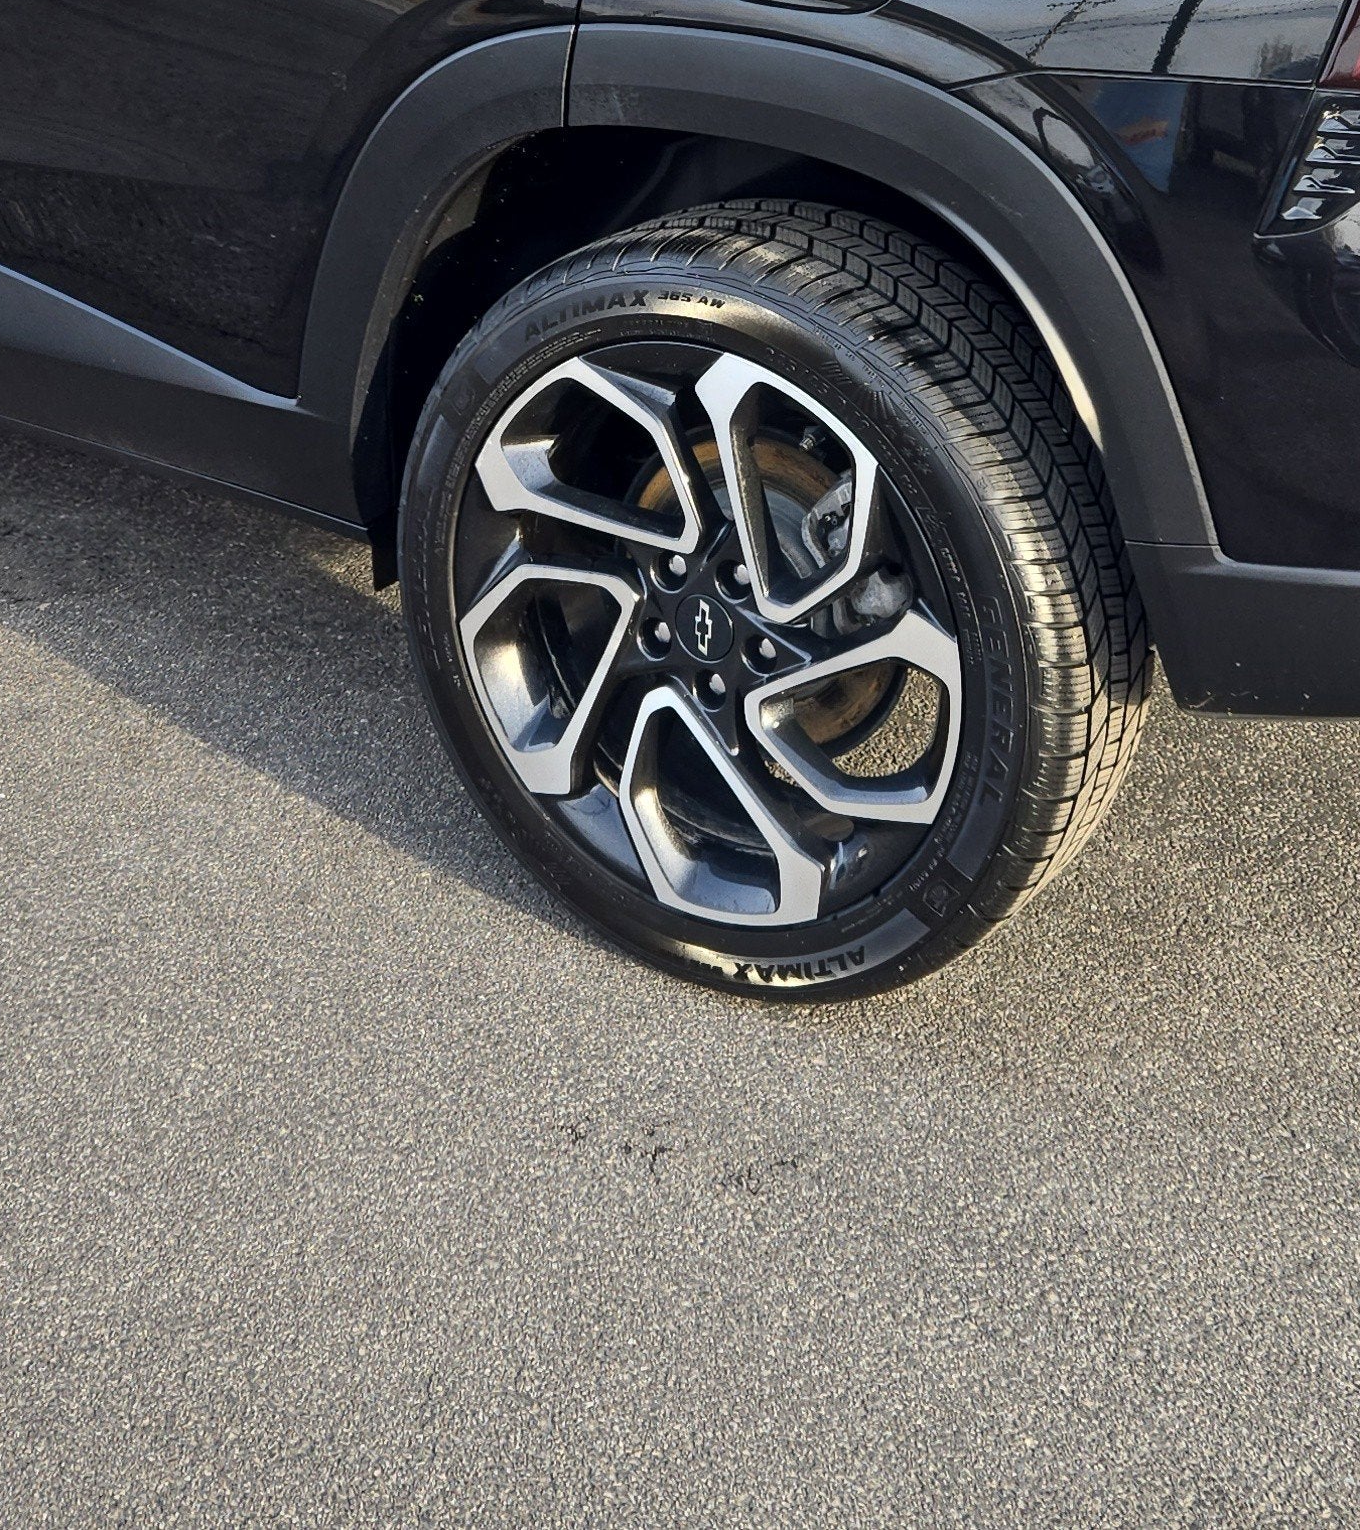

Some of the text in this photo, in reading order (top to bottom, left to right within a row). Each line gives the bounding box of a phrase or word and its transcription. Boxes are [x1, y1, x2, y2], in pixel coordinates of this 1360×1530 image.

[523, 289, 650, 343] ALTIMAX
[657, 290, 694, 303] 365
[696, 295, 727, 309] AW
[732, 945, 866, 983] ALTIMAX
